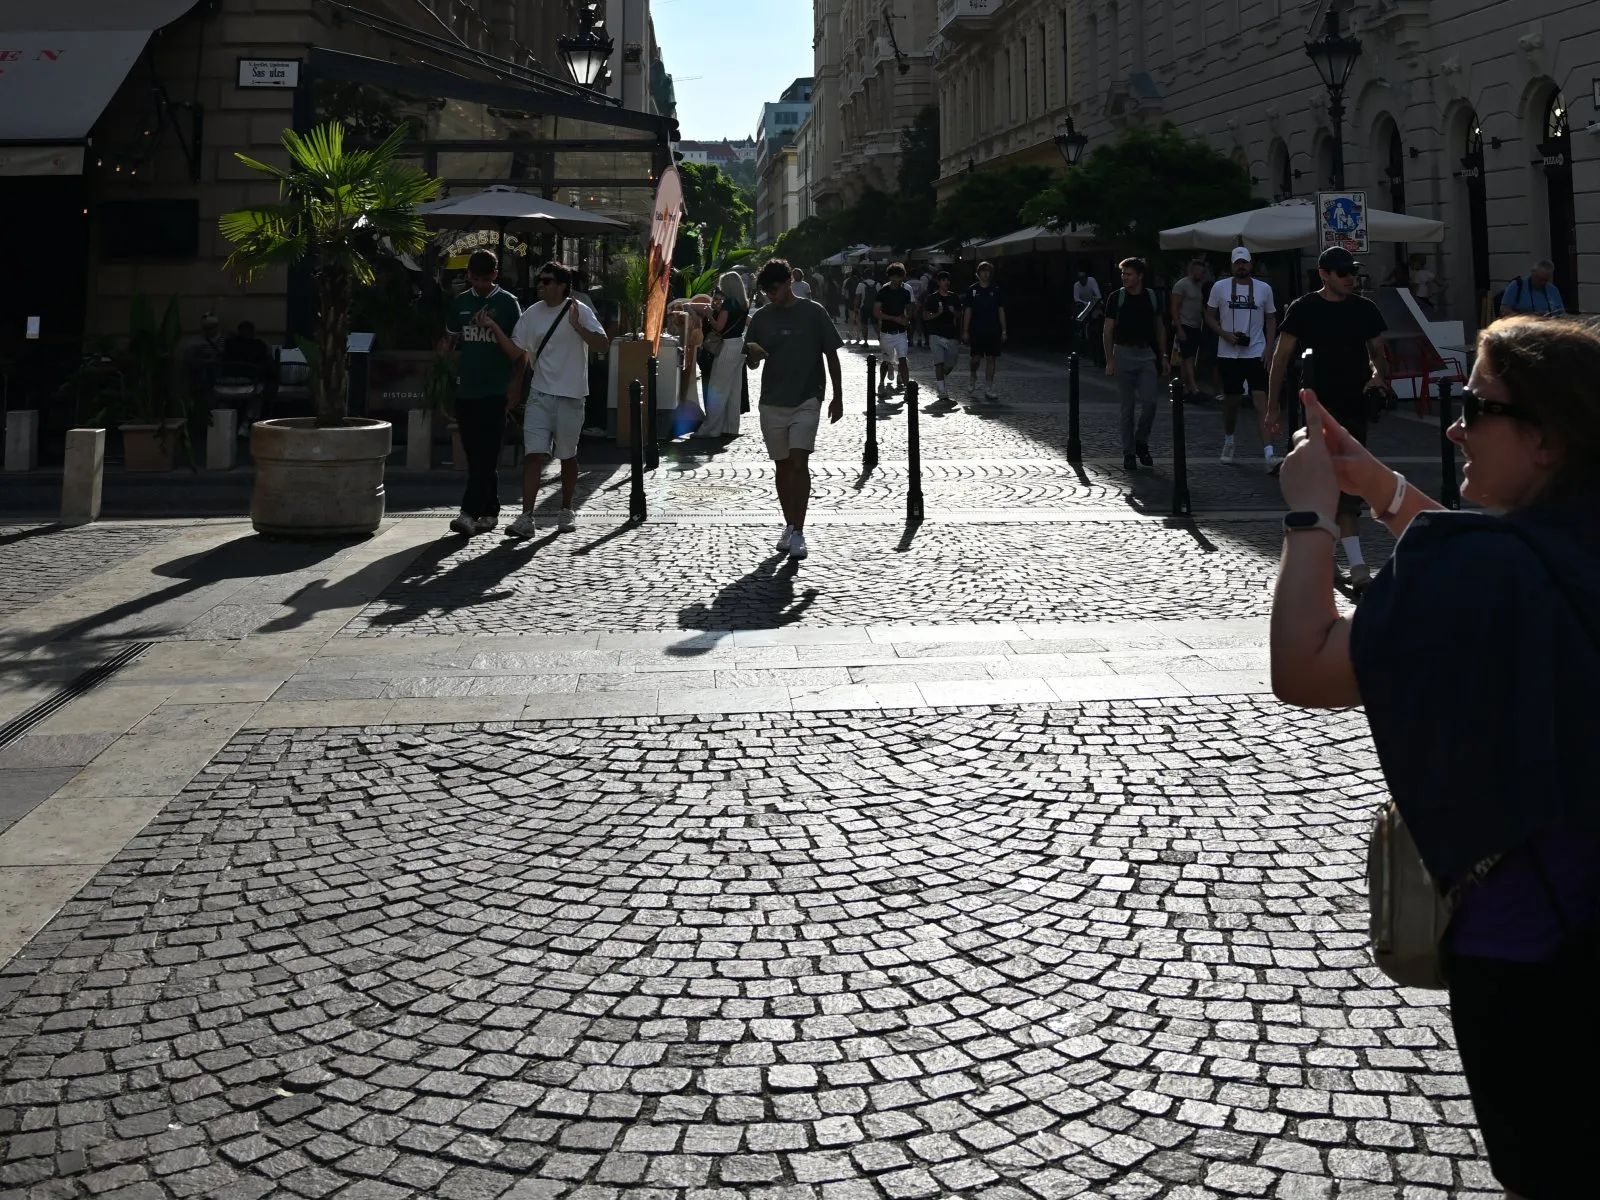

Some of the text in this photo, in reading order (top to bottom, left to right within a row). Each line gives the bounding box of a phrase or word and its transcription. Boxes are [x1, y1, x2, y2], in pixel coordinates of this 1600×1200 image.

[252, 67, 285, 78] Sas utca
[446, 230, 528, 257] FABBRCA
